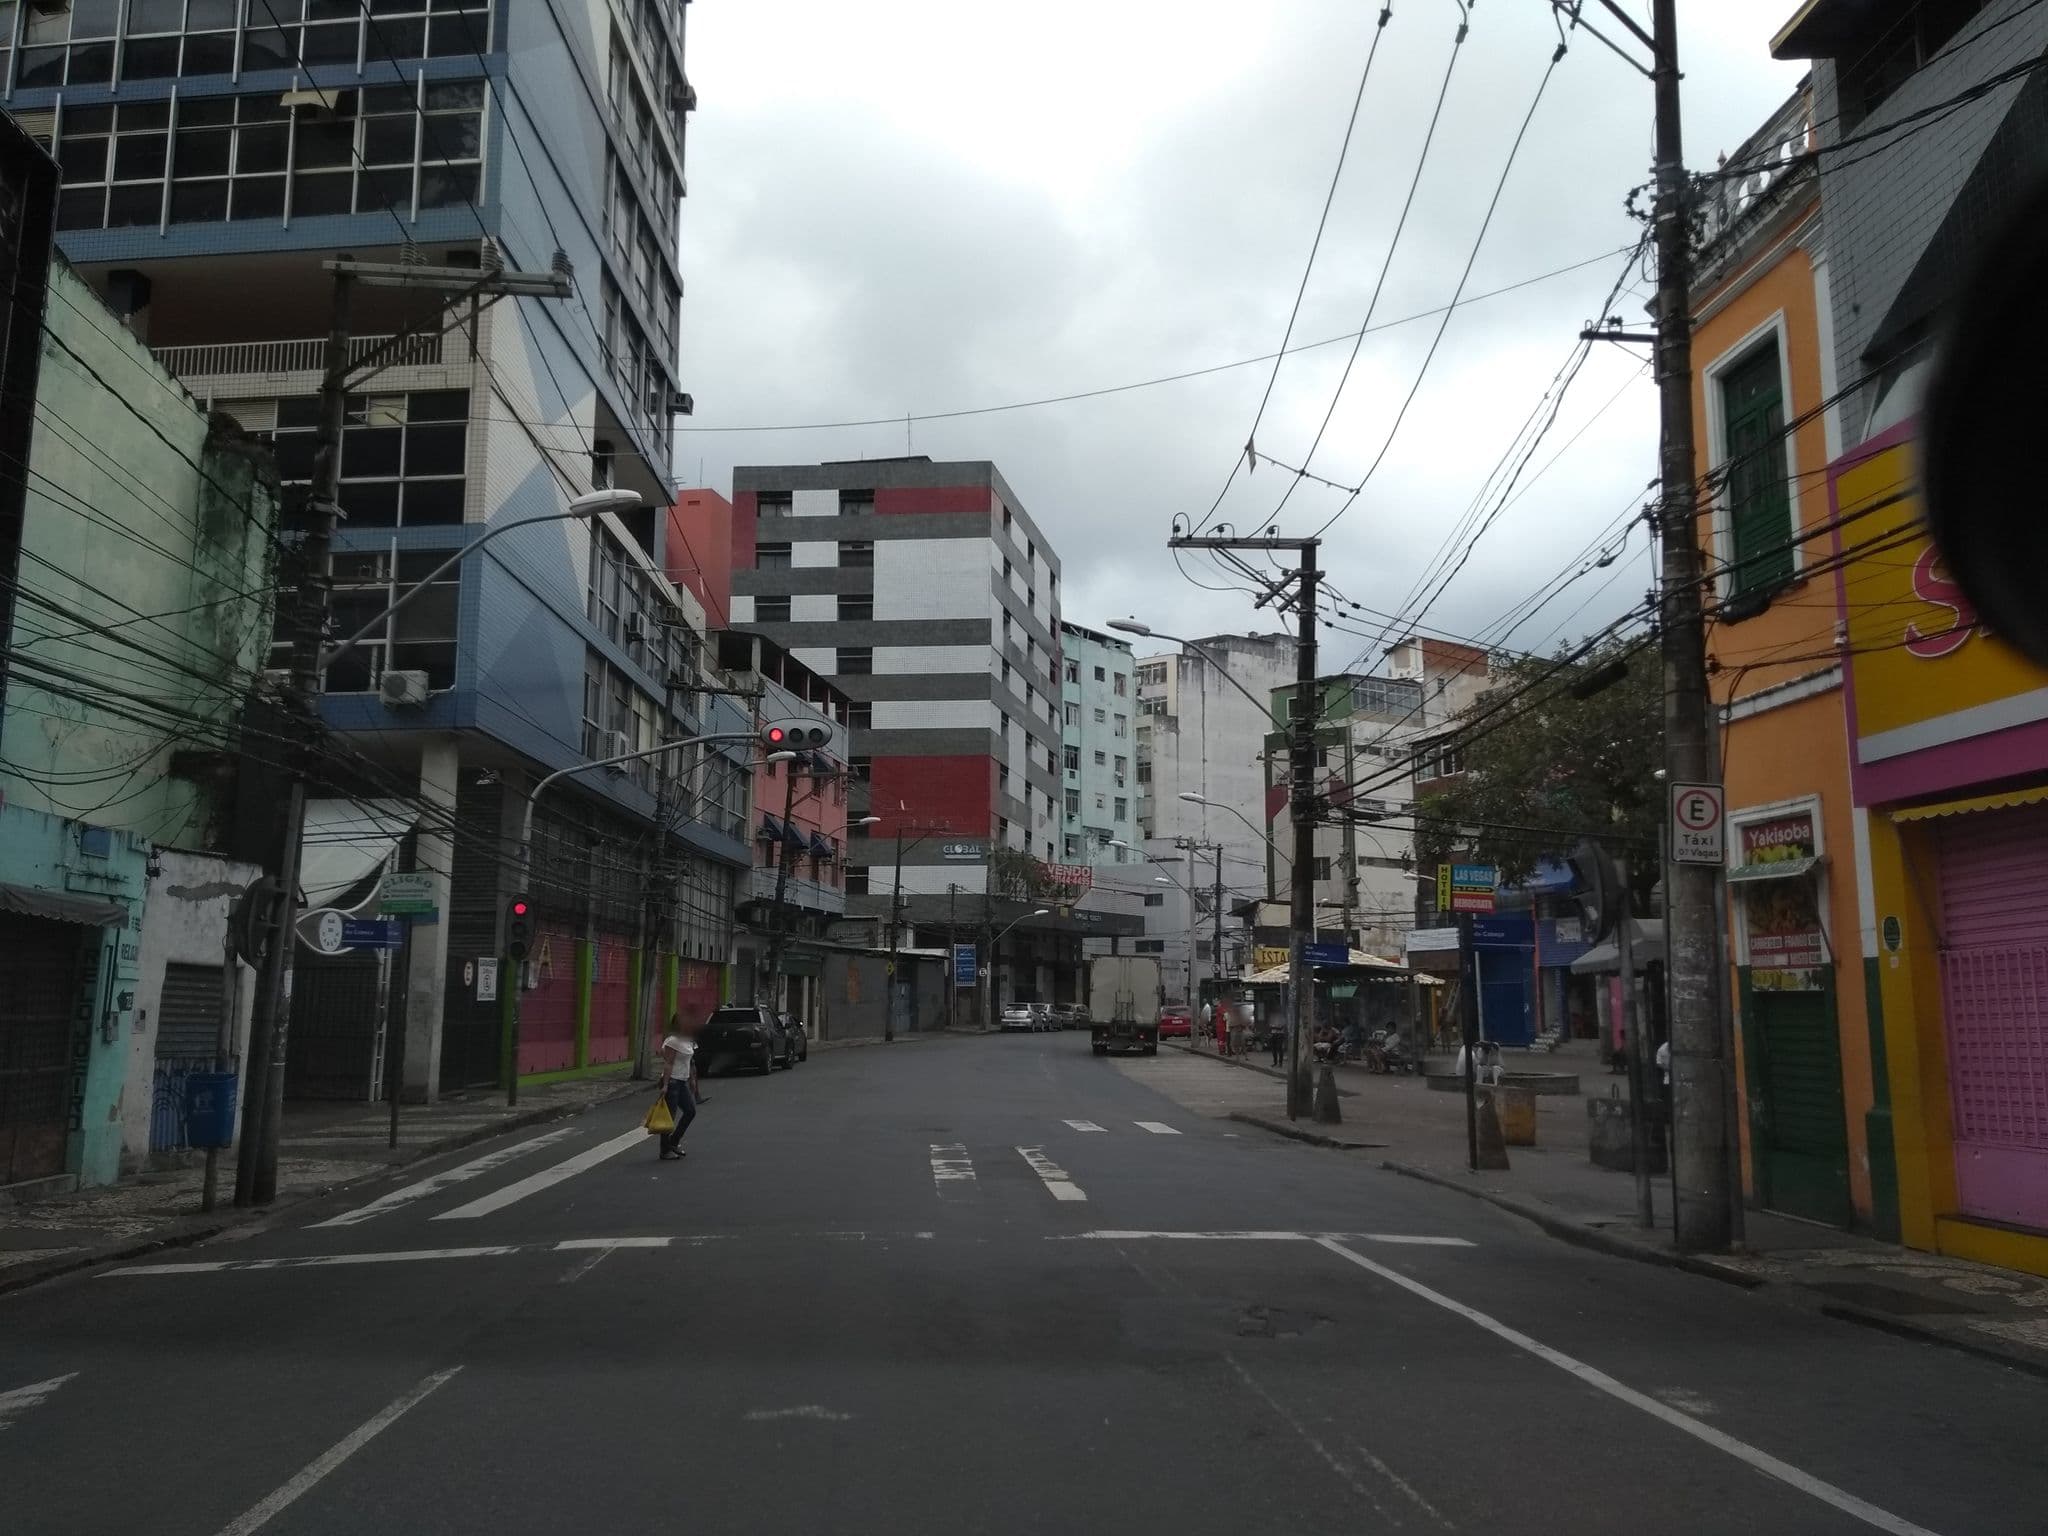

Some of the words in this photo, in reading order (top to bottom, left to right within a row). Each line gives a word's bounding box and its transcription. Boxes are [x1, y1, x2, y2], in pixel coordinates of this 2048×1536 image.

[1690, 799, 1705, 821] E
[1682, 833, 1714, 846] Táxi
[1749, 823, 1811, 847] Yakisoba
[943, 843, 982, 854] GLOBAL
[1691, 848, 1719, 859] Vagas
[1047, 863, 1091, 877] VENDO
[1454, 869, 1468, 882] LAS
[1468, 870, 1494, 883] VEGAS
[1262, 950, 1291, 965] ESTA
